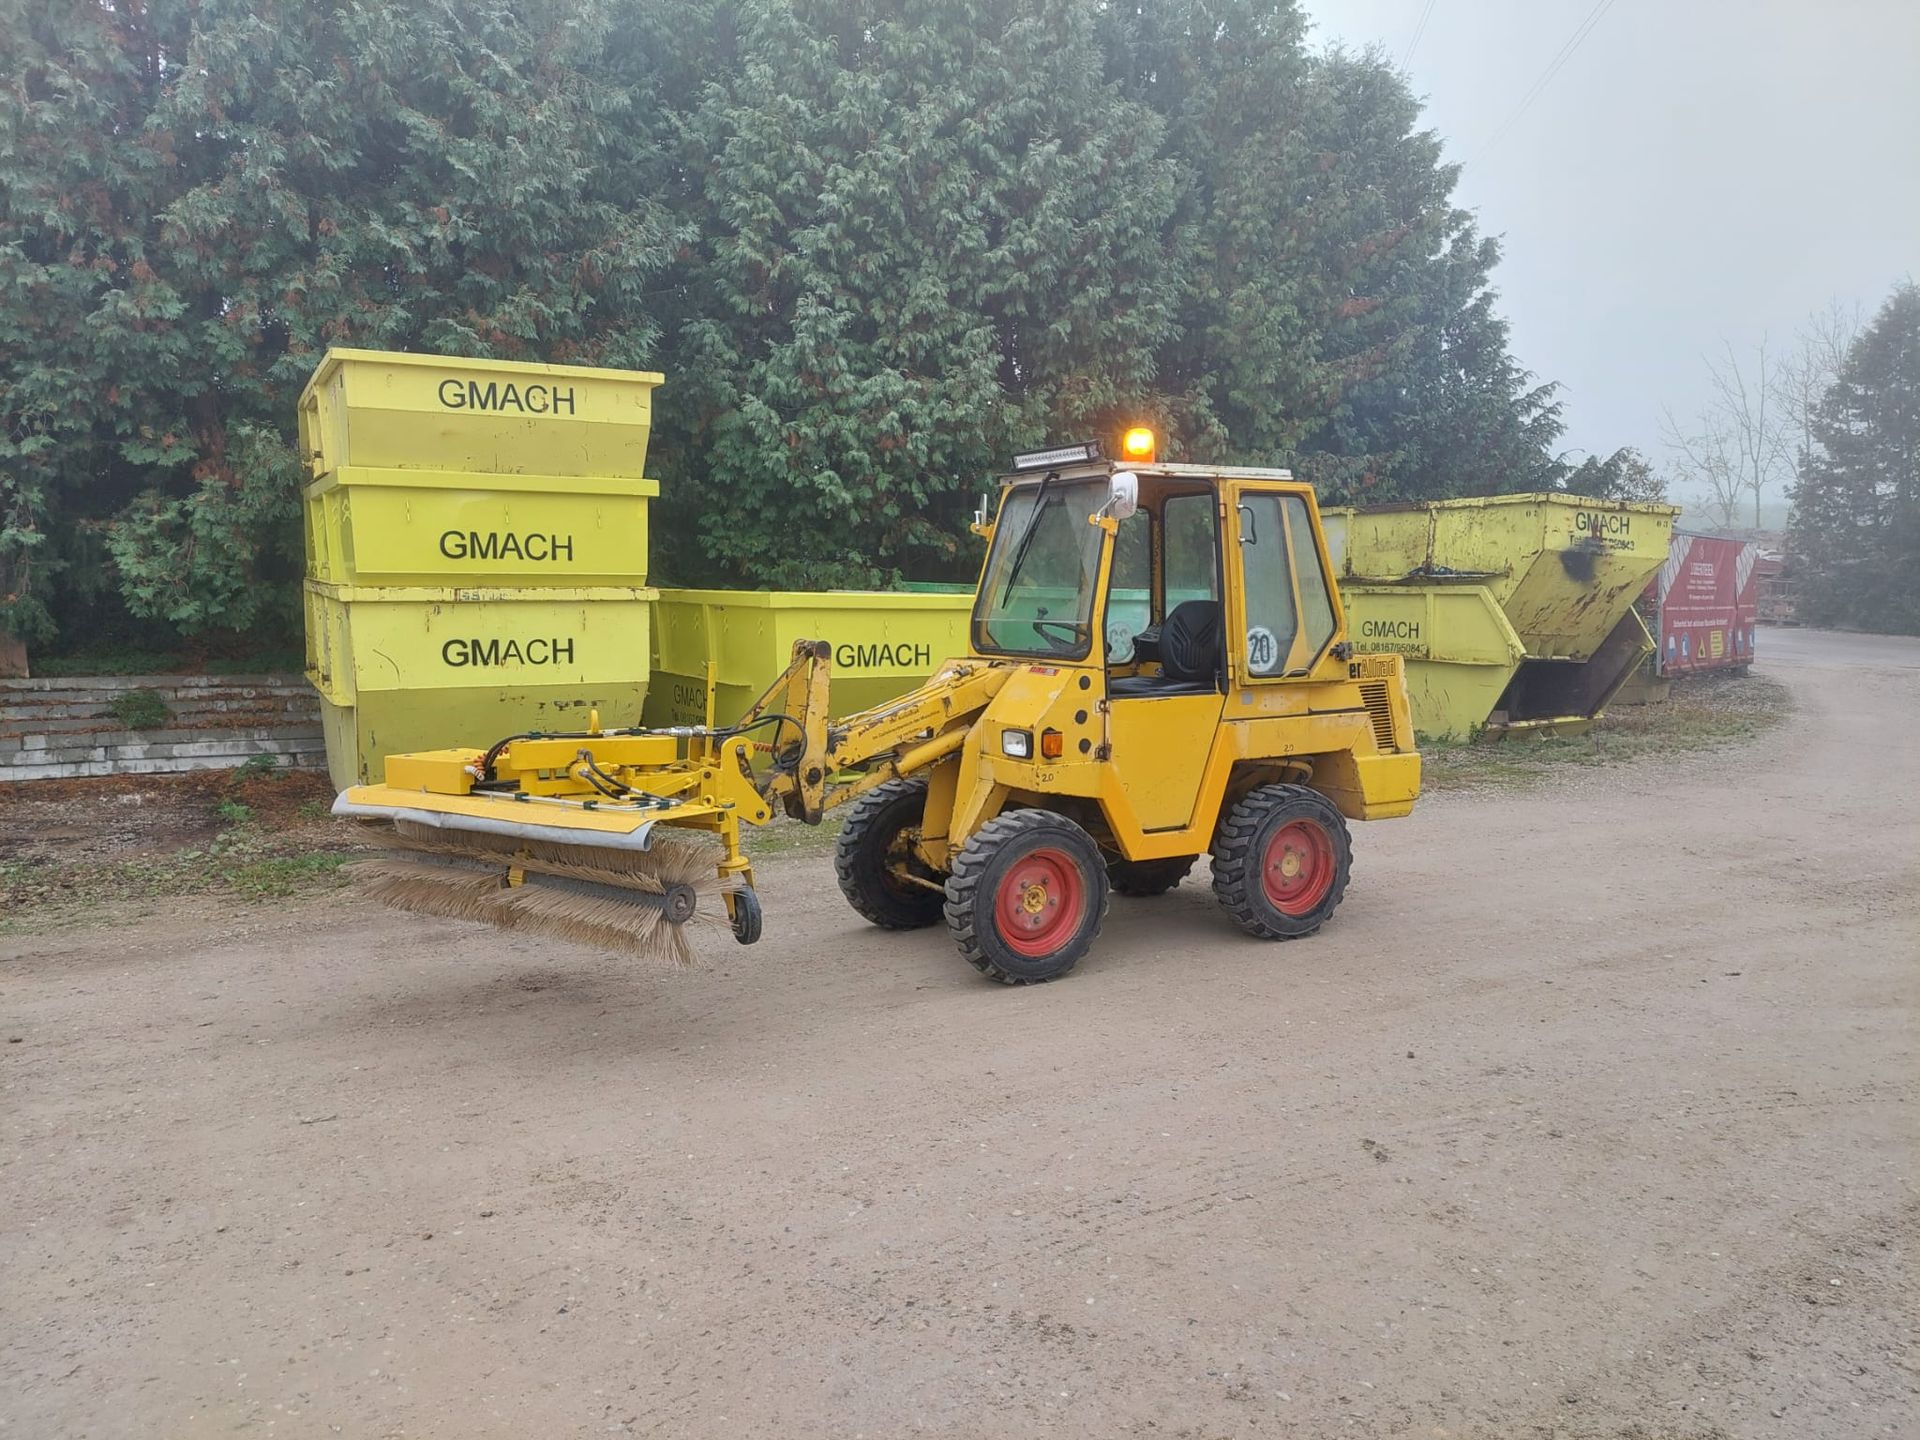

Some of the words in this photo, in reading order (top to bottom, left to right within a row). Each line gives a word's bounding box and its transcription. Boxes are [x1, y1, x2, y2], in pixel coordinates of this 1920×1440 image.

[438, 379, 575, 415] GMACH
[1576, 512, 1630, 535] GMACH
[440, 530, 573, 561] GMACH
[1362, 621, 1419, 639] GMACH
[442, 638, 574, 667] GMACH
[836, 643, 930, 669] GMACH
[1248, 634, 1270, 664] 20
[1356, 642, 1369, 652] Tel.
[1370, 642, 1423, 654] 08167/95084
[1041, 773, 1054, 782] 20
